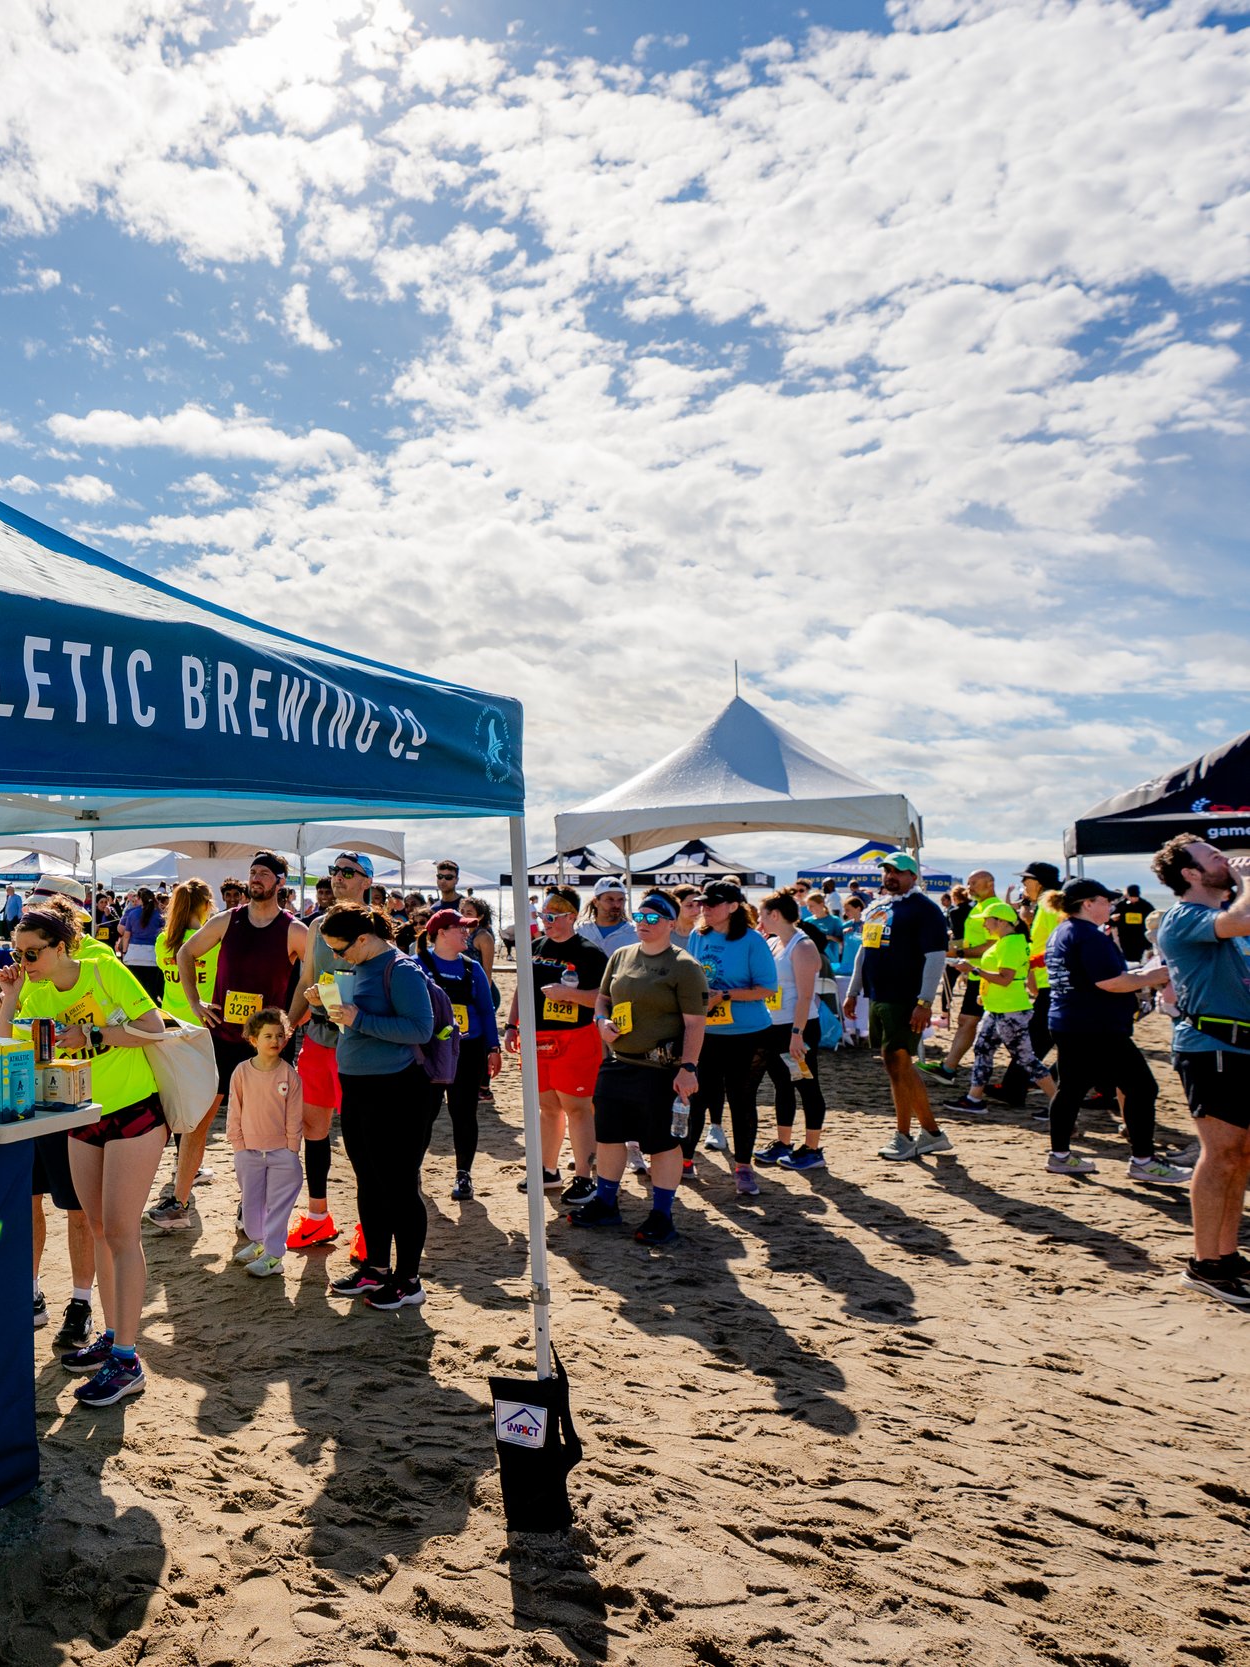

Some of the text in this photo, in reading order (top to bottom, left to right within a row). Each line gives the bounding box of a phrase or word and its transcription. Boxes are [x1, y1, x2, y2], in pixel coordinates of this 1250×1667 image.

[181, 655, 381, 754] BREWING
[533, 874, 580, 885] KANE
[655, 874, 705, 885] KANE
[164, 970, 207, 984] GUE
[229, 1003, 257, 1017] 3283
[546, 1002, 573, 1015] 3928
